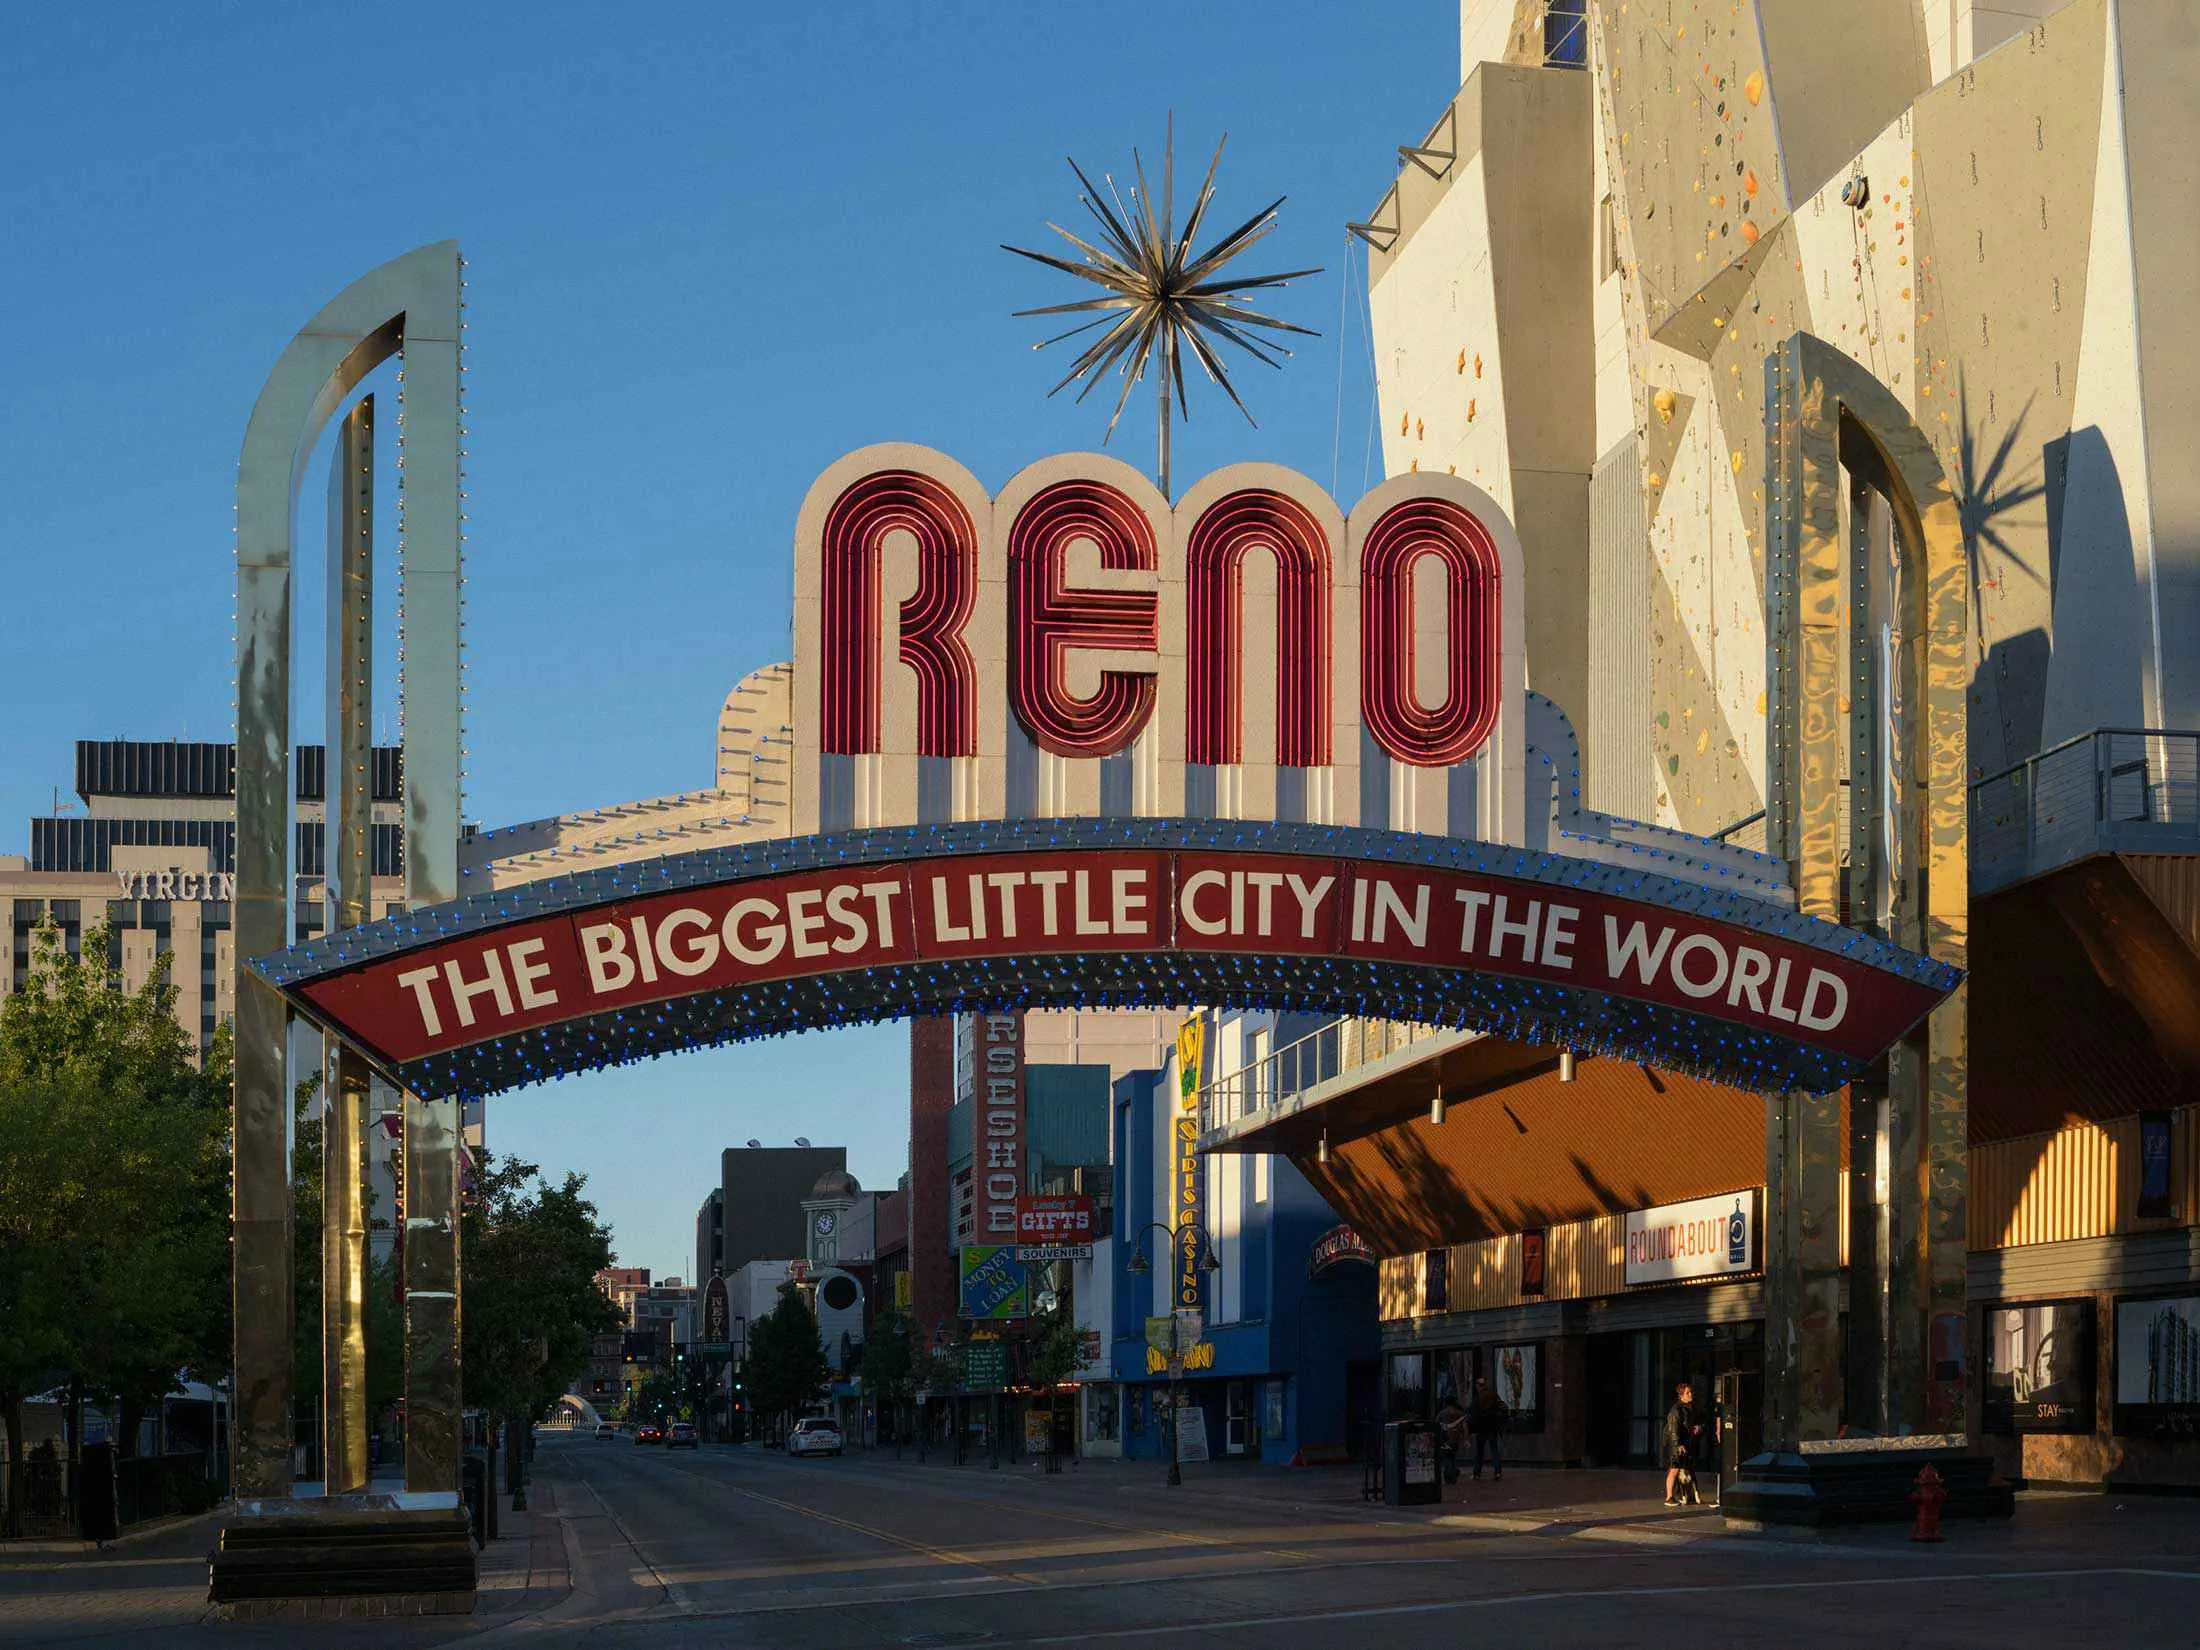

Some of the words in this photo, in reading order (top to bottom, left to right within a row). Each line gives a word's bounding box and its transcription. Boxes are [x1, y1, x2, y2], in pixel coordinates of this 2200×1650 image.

[398, 937, 559, 1037] THE
[580, 880, 901, 995] BIGGEST
[932, 869, 1147, 942] LITTLE
[1180, 870, 1336, 939] CITY
[1352, 878, 1431, 948] IN
[1455, 888, 1580, 970] THE
[1604, 914, 1849, 1032] WORLD
[1021, 1211, 1089, 1231] GIFTS
[1023, 1247, 1087, 1259] SOUVENIRS
[1180, 1208, 1199, 1305] CASINO
[1315, 1232, 1350, 1264] DOUGLAS
[1630, 1216, 1727, 1265] ROUNDABOUT
[963, 1247, 1012, 1291] MONEY
[987, 1269, 1007, 1289] TO
[980, 1276, 1018, 1313] LOAN
[2037, 1403, 2060, 1419] STAY
